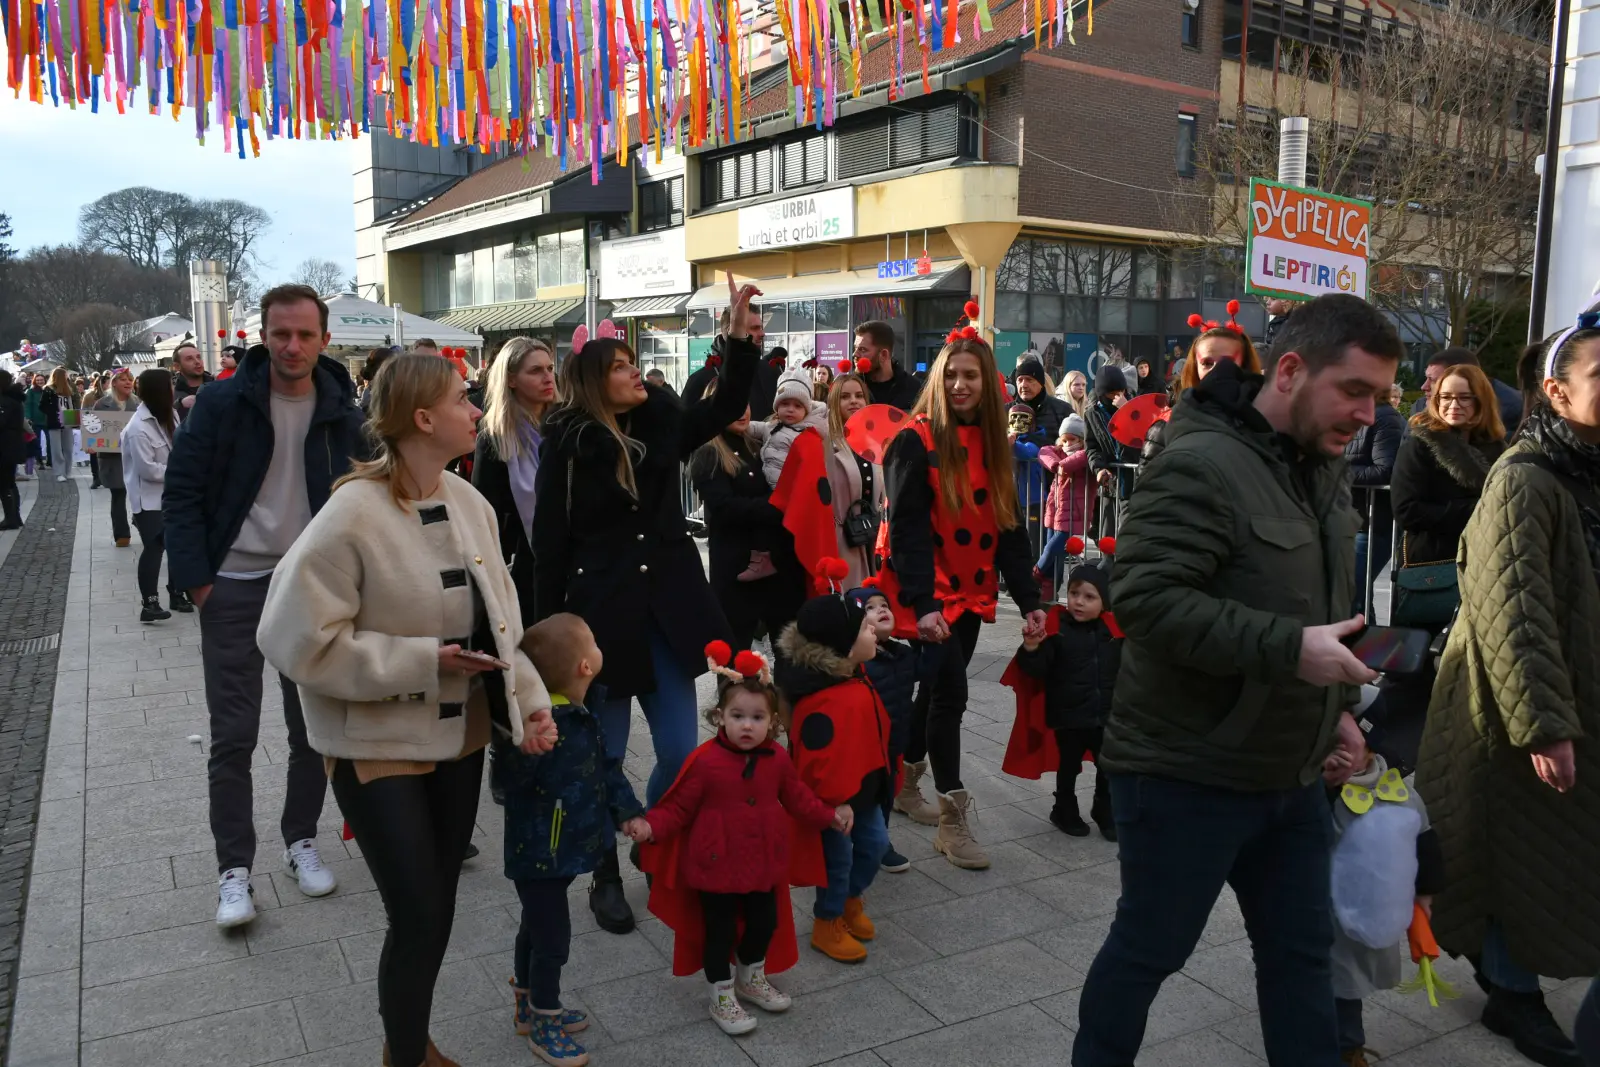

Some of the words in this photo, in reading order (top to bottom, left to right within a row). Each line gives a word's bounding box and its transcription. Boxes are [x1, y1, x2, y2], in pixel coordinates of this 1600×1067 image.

[782, 198, 816, 219] URBIA
[748, 228, 772, 246] urbi
[775, 226, 788, 243] et
[792, 220, 818, 240] orbi
[823, 217, 840, 236] 25
[878, 258, 917, 278] ERSTE
[1262, 253, 1356, 292] LEPTIRIĆI
